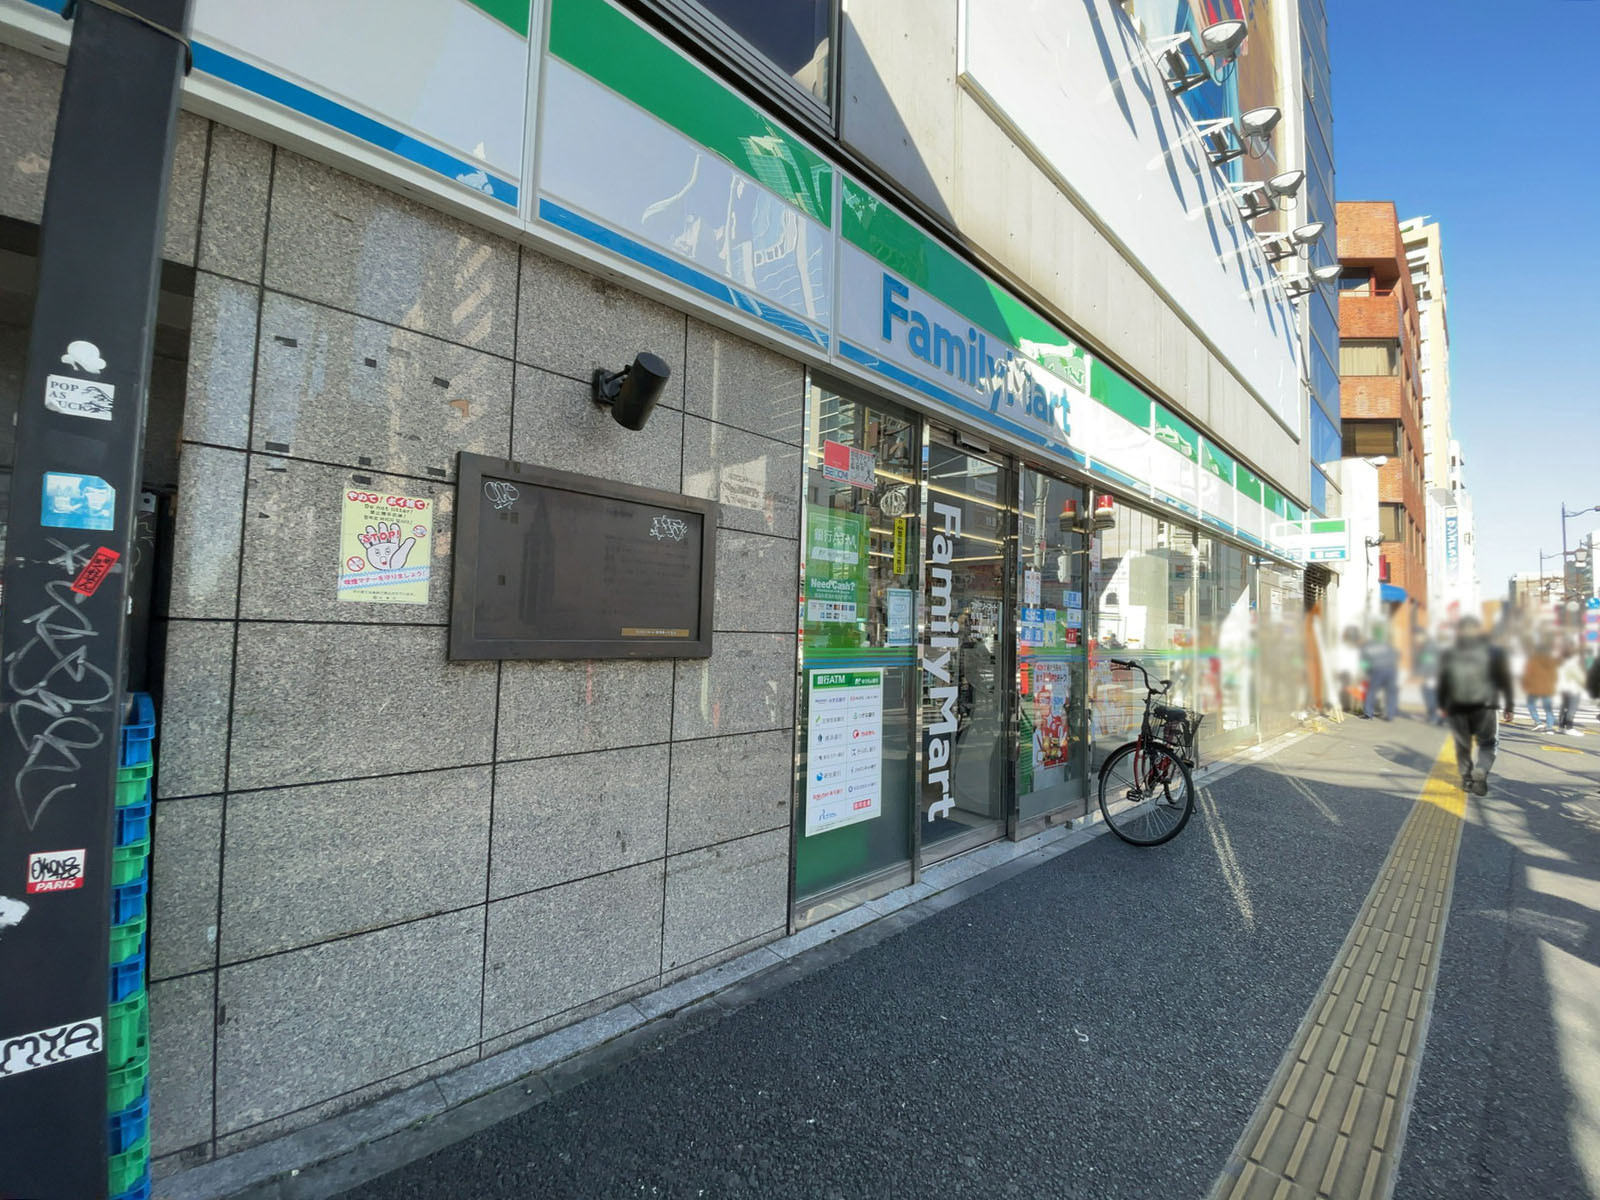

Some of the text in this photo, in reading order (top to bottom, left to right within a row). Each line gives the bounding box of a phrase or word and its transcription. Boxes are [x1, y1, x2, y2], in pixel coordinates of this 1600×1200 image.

[882, 271, 1072, 438] FamilyMart
[50, 381, 79, 391] POP
[49, 391, 67, 399] AS
[58, 400, 88, 412] UCK
[363, 530, 401, 543] STOP!
[810, 577, 831, 589] Need
[922, 501, 961, 823] FamilyMart
[35, 880, 76, 892] PARIS
